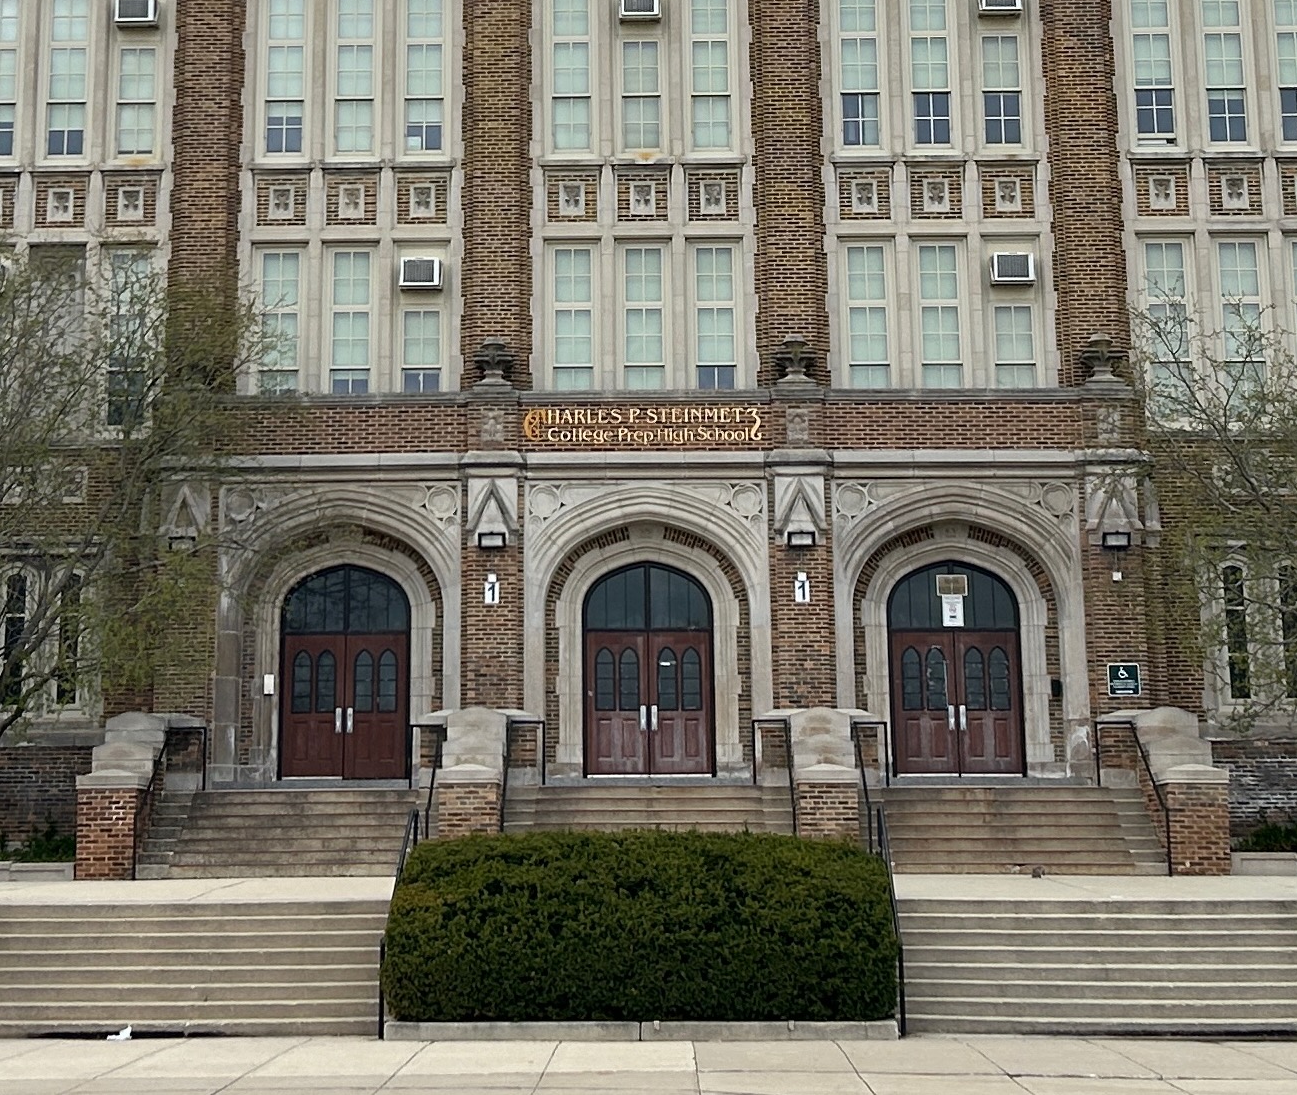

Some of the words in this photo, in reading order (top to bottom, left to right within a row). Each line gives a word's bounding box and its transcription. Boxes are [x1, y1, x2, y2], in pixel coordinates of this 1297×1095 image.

[523, 408, 622, 441] CHARLES
[646, 407, 762, 441] STEINMETZ
[547, 427, 614, 443] College
[618, 427, 654, 445] Prep
[657, 427, 694, 444] High
[696, 426, 749, 441] School
[487, 582, 495, 602] 1
[797, 581, 806, 601] 1
